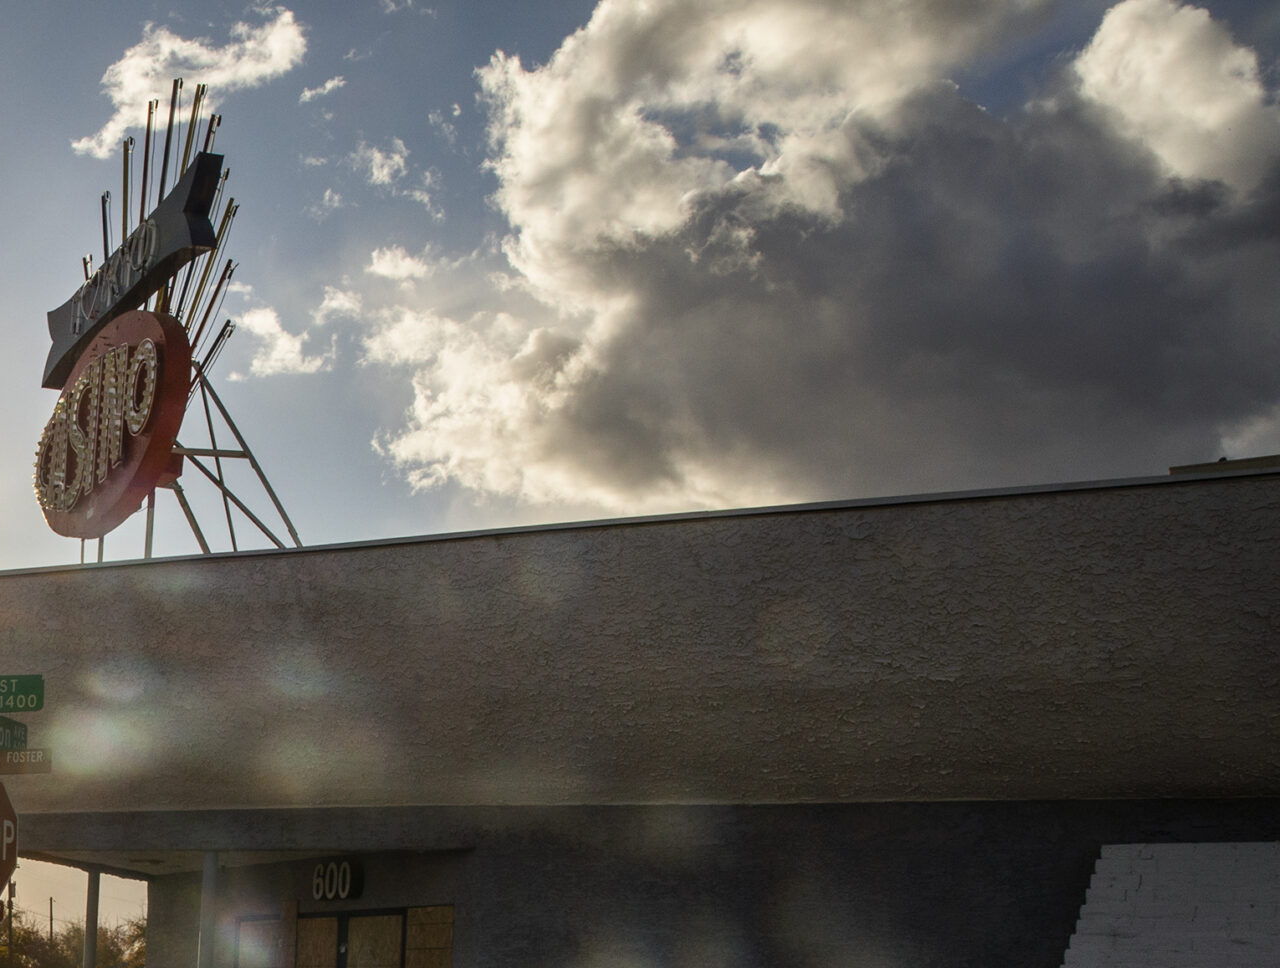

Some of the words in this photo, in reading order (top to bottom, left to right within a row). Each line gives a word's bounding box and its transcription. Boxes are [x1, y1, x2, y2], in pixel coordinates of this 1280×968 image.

[0, 679, 18, 693] ST
[0, 694, 37, 708] 1400
[6, 750, 44, 763] FOSTER
[312, 861, 351, 900] 600
